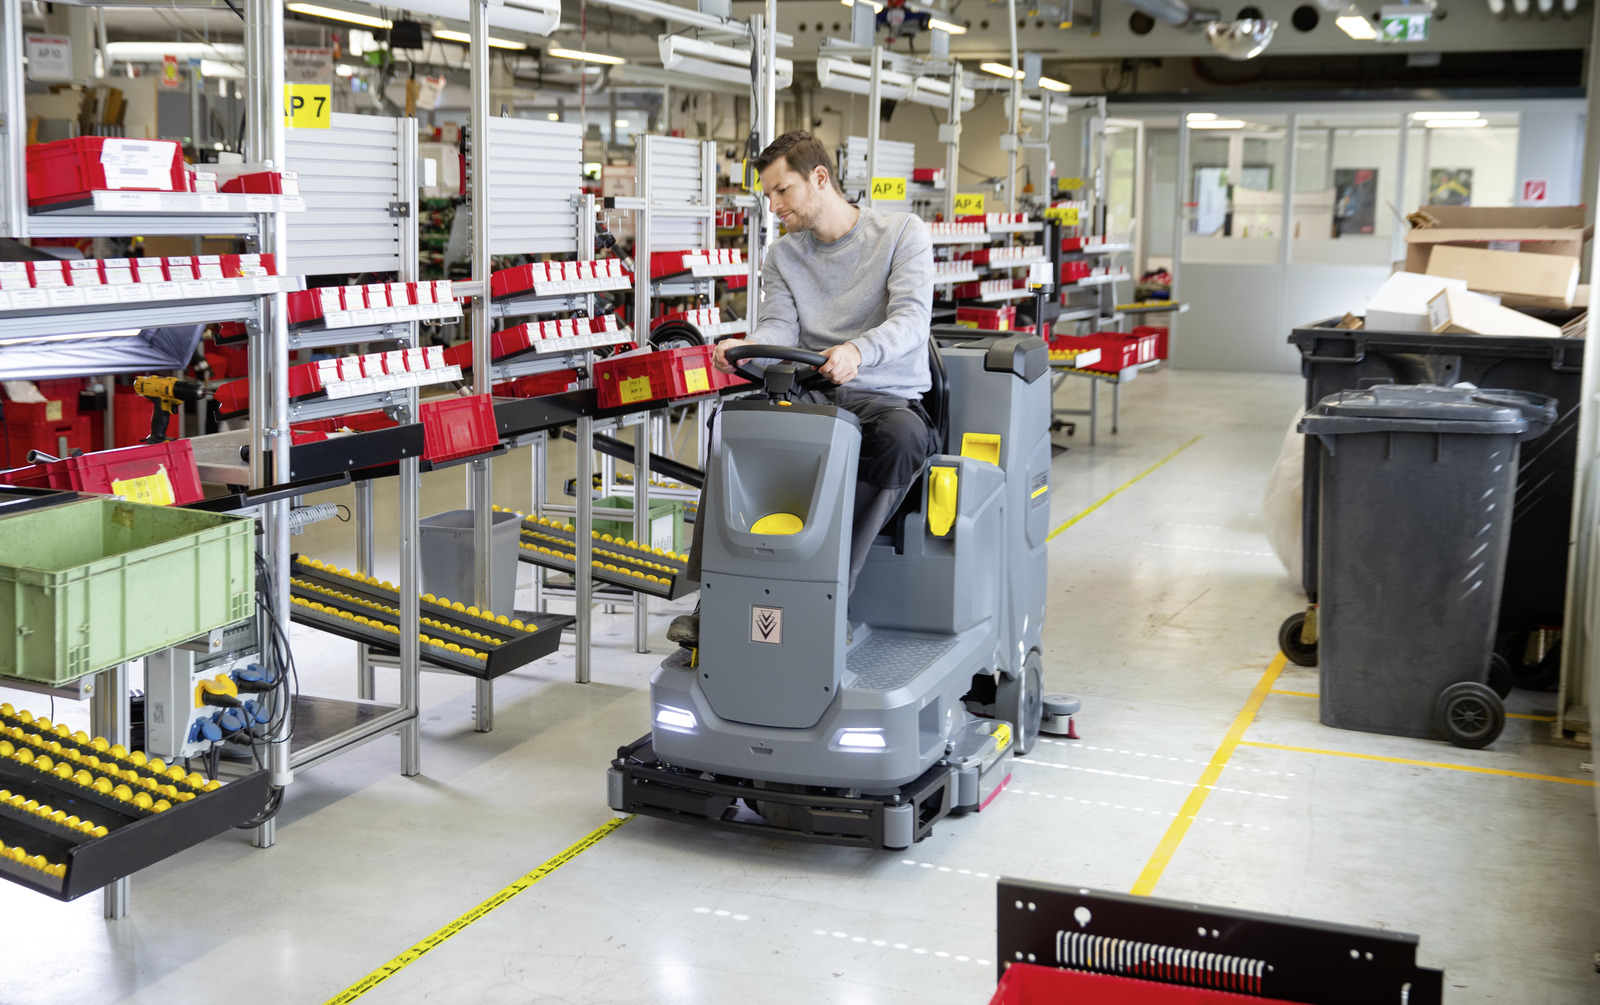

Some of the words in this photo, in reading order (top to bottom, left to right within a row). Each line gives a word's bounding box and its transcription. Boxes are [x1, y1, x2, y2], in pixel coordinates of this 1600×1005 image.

[284, 96, 305, 117] P
[313, 96, 327, 118] 7
[873, 183, 892, 194] AP
[897, 183, 905, 195] 5
[955, 199, 972, 209] AP
[975, 199, 982, 209] 4
